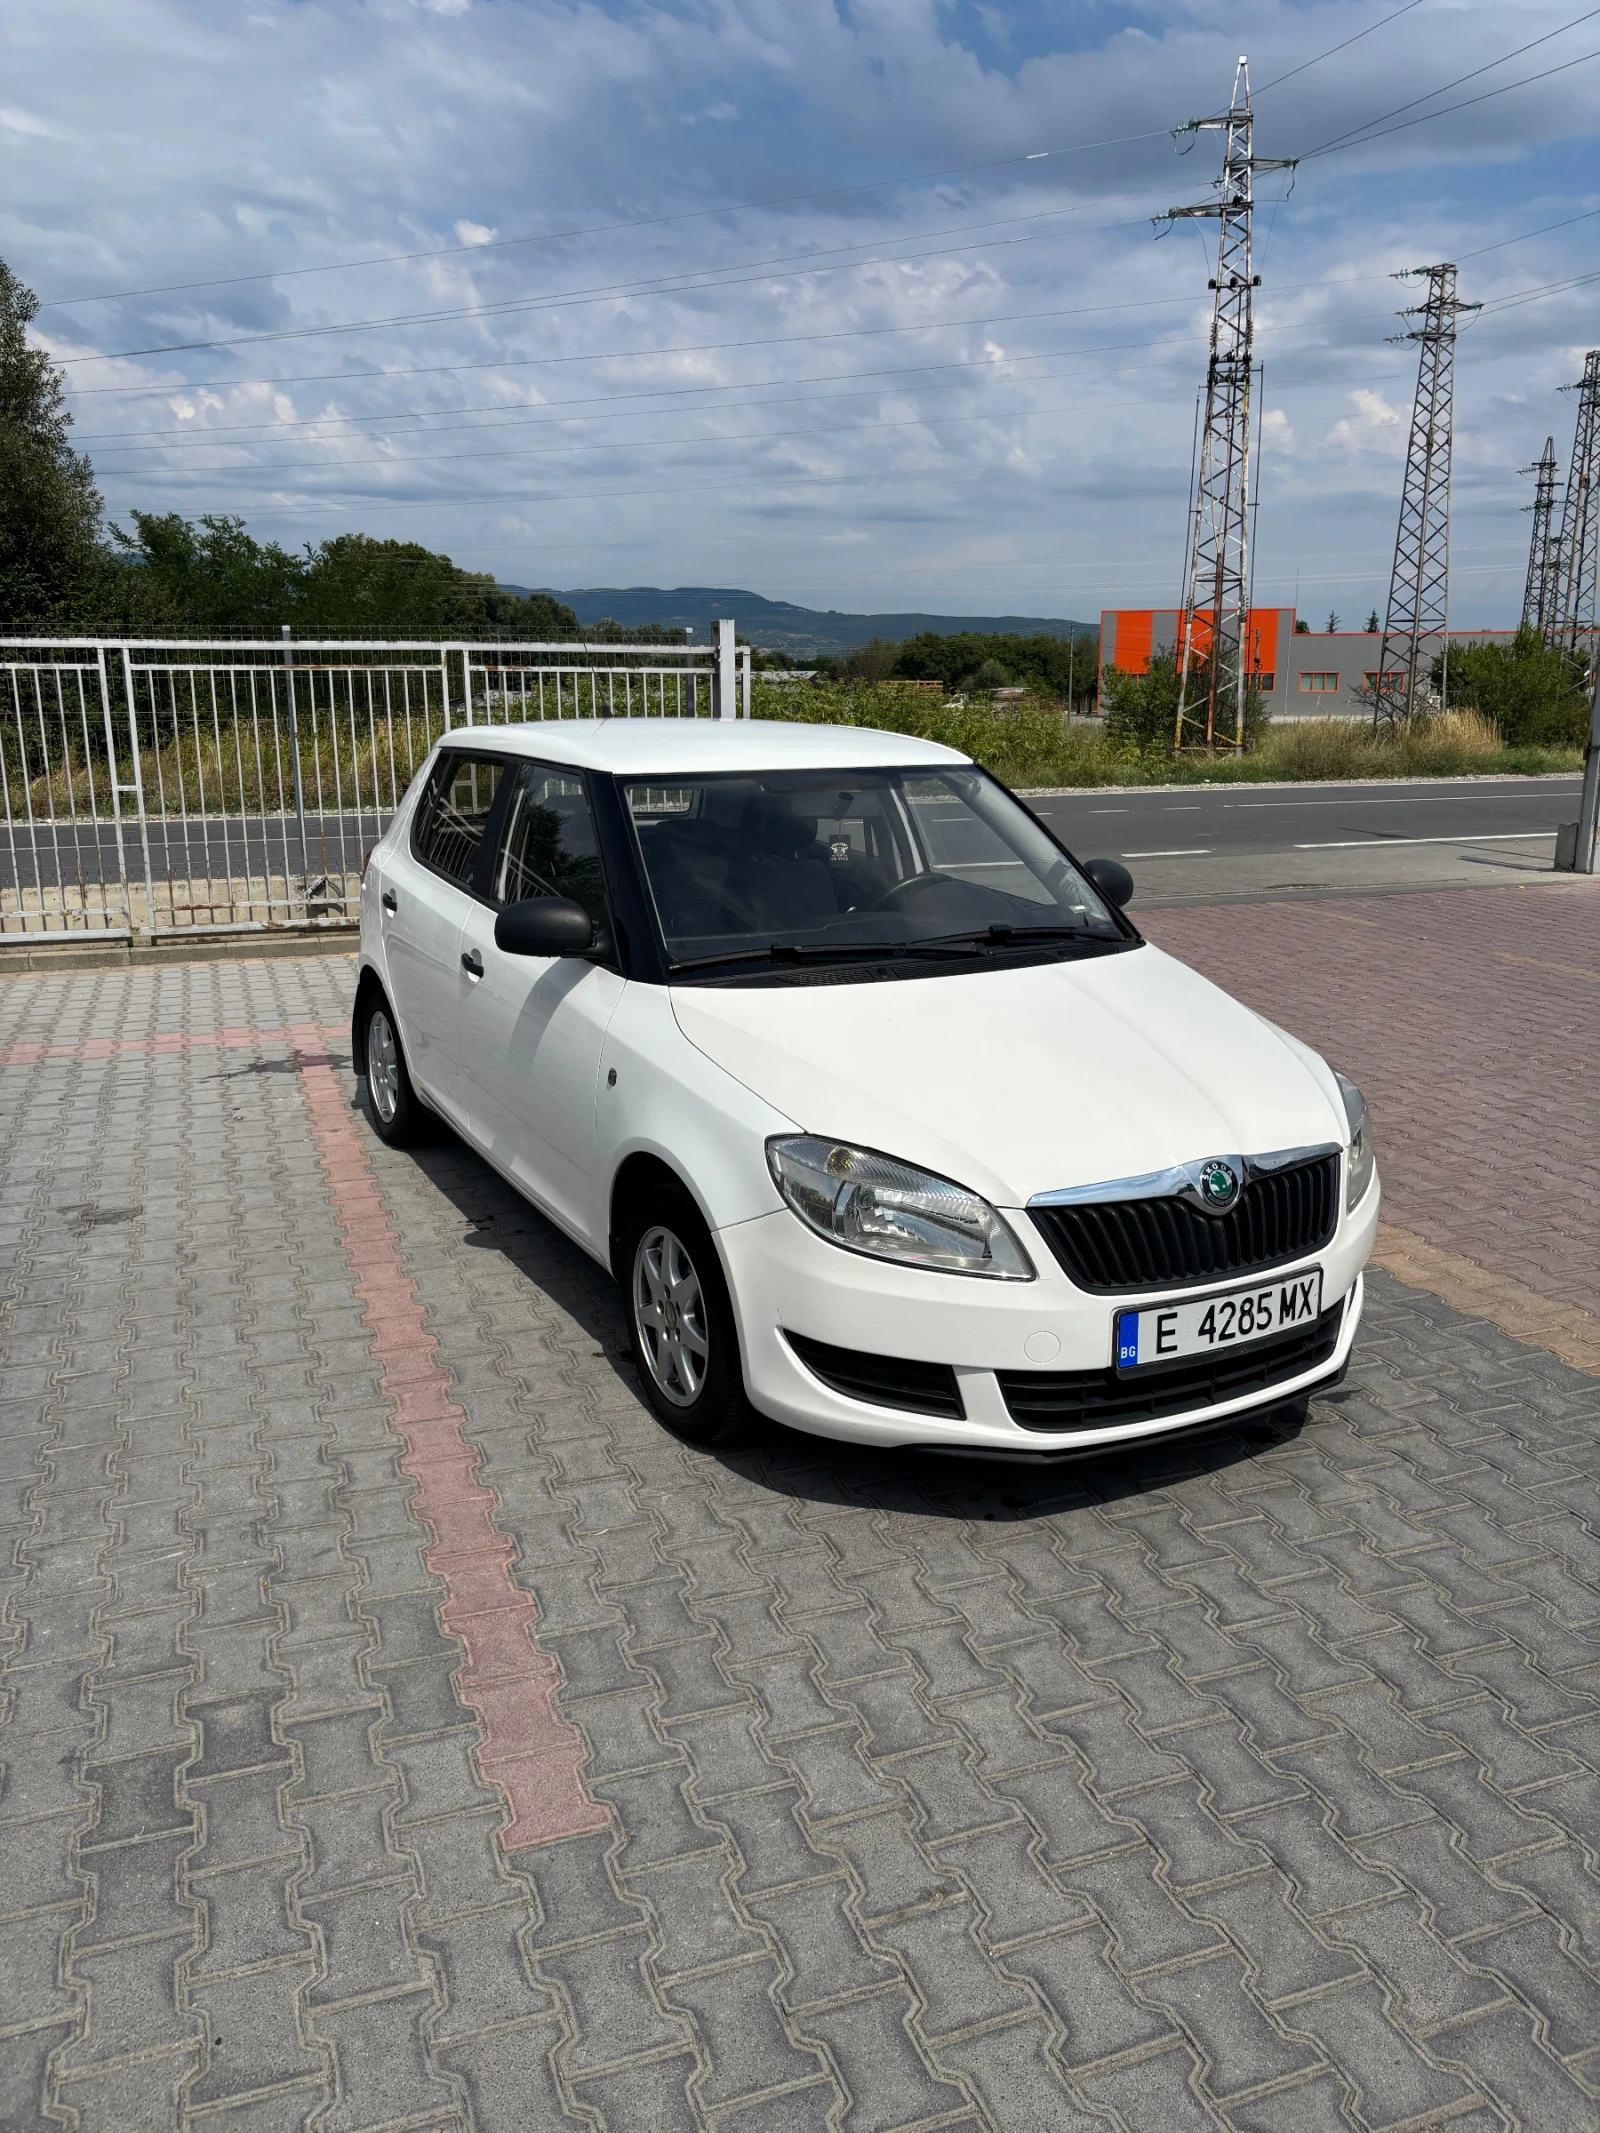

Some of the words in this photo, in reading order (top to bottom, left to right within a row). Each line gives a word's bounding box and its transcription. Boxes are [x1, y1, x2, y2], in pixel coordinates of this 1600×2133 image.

[1157, 1312, 1178, 1354] E
[1198, 1291, 1273, 1344] 4285
[1279, 1278, 1315, 1325] MX
[1120, 1345, 1136, 1359] BG
